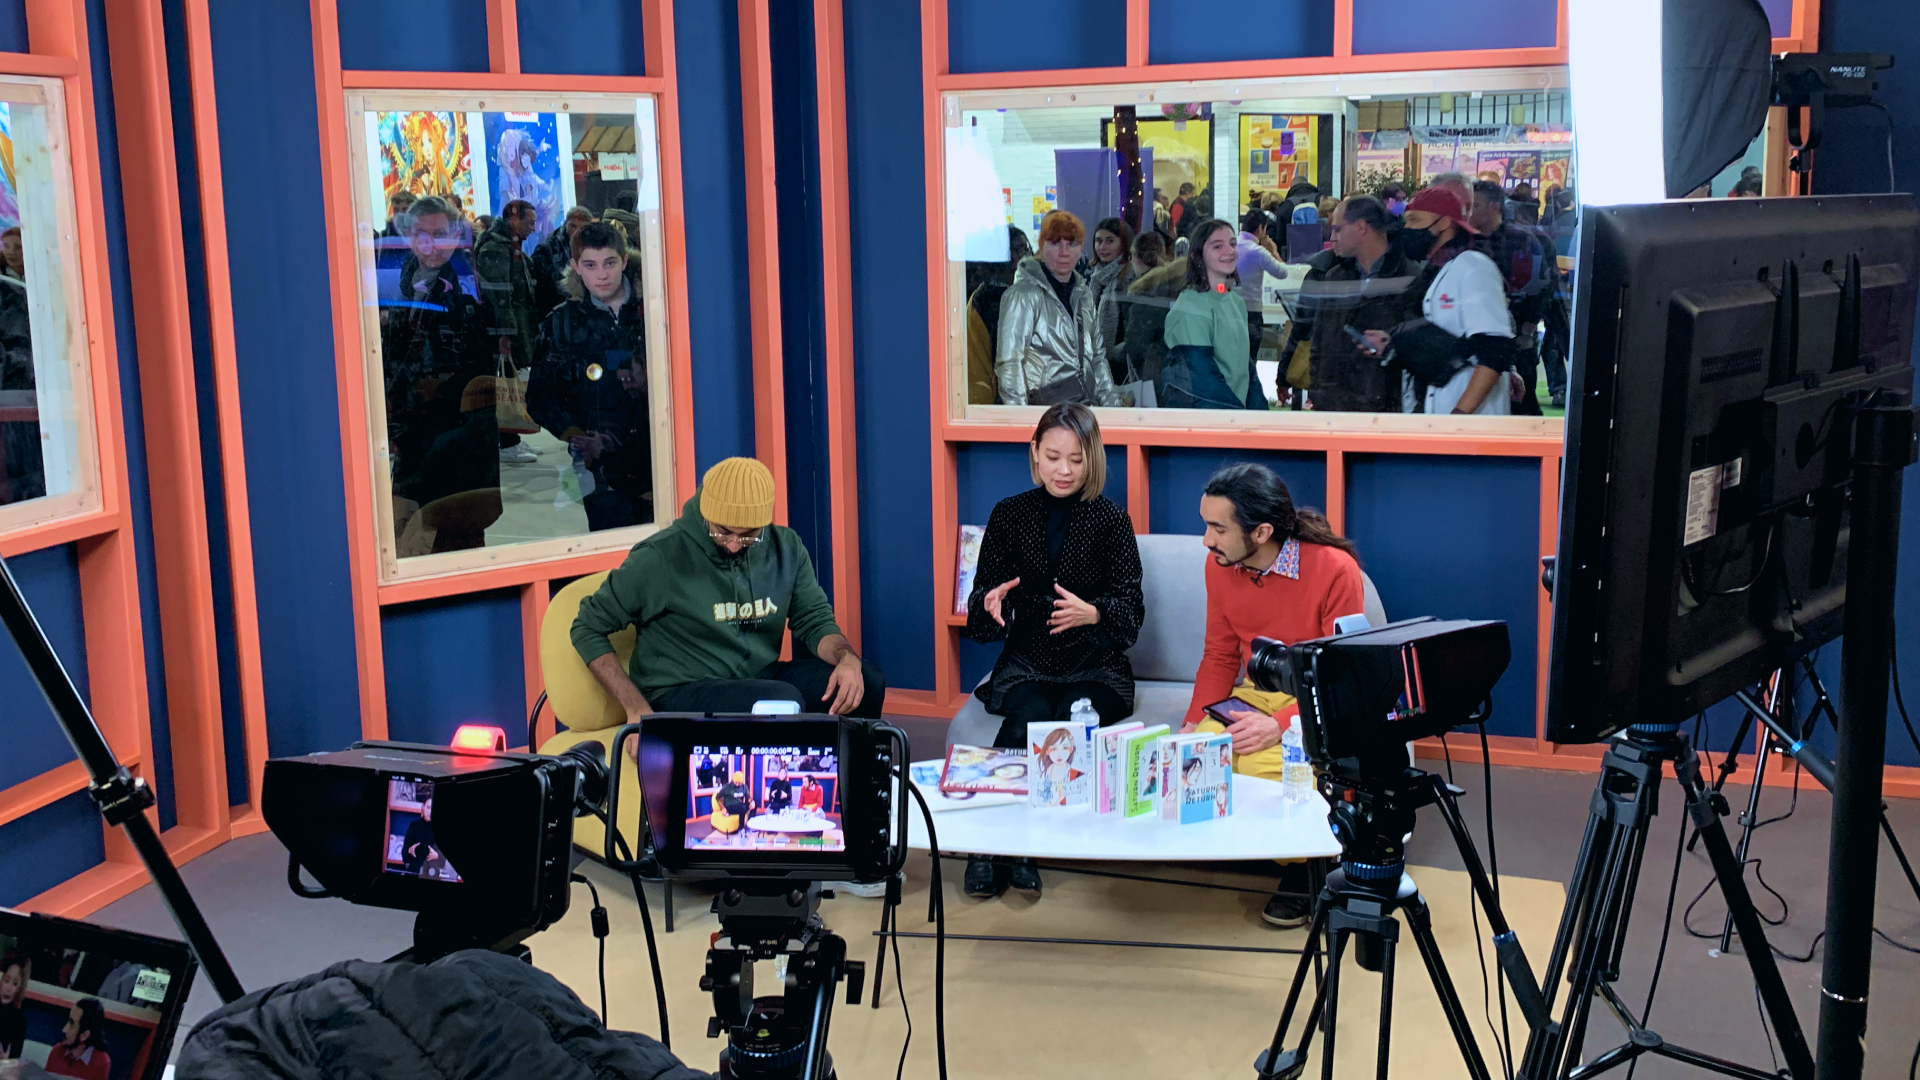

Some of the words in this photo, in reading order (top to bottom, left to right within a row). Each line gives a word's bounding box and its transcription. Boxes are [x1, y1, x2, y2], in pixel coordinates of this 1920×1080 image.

[1460, 127, 1501, 137] ACADEMY
[1211, 758, 1217, 768] 3
[1185, 785, 1216, 796] SATURN
[1185, 794, 1216, 805] RETURN
